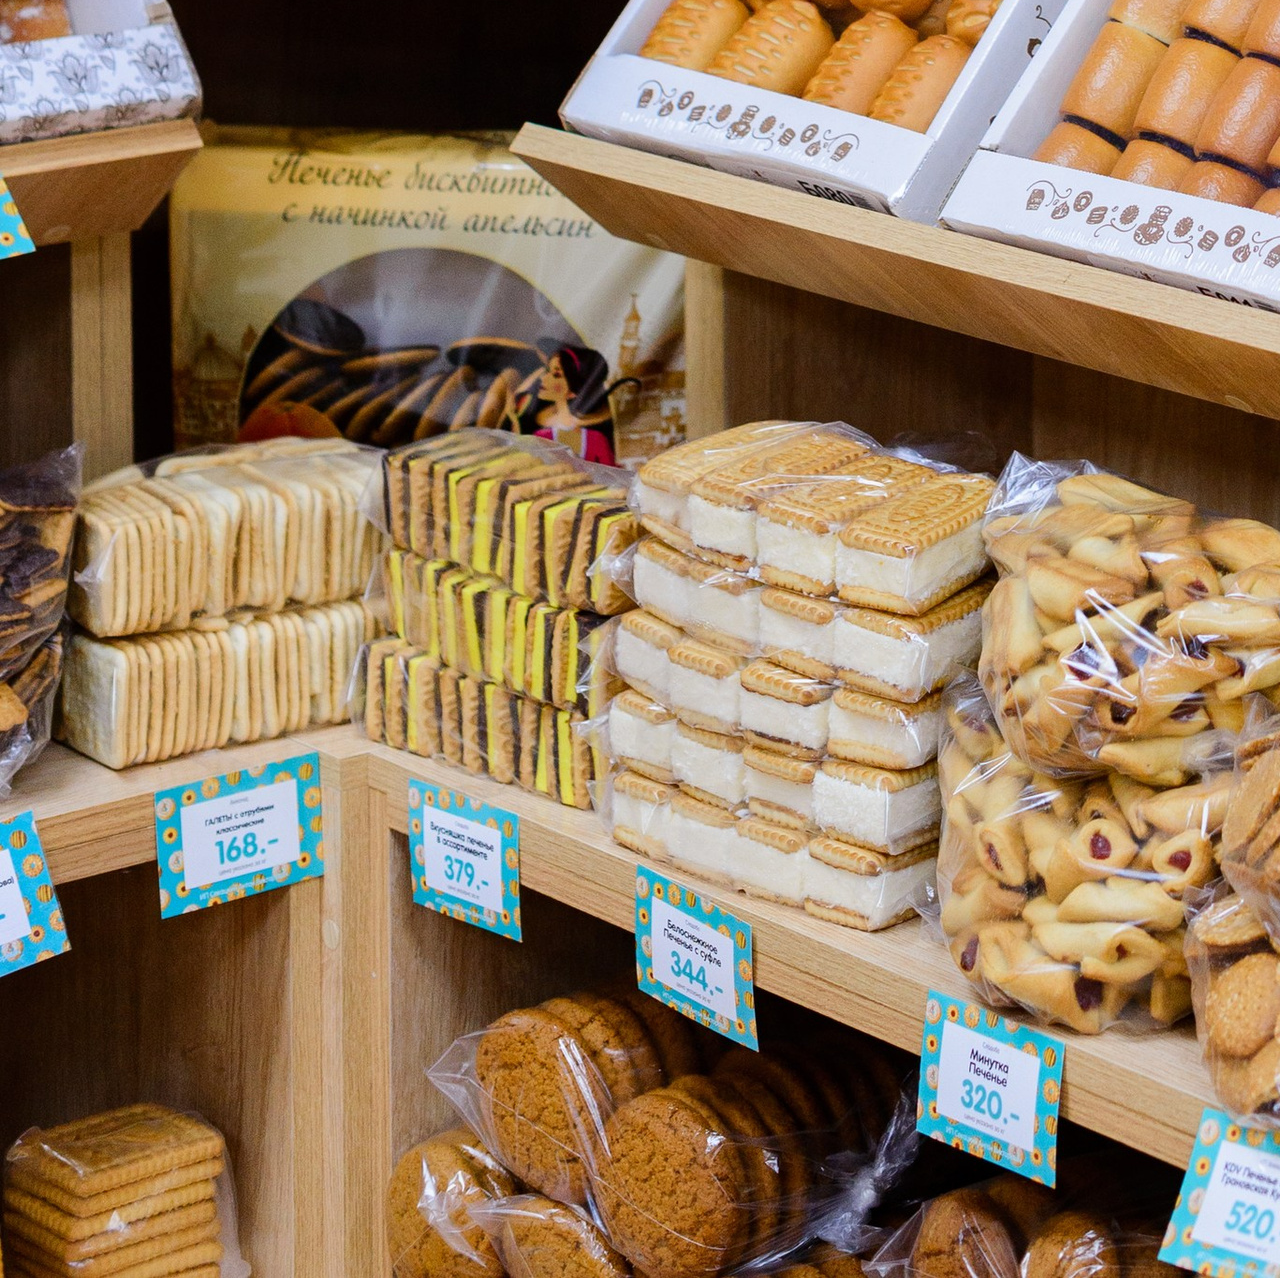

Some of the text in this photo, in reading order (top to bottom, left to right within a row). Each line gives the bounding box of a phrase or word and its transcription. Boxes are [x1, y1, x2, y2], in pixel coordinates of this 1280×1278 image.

[267, 151, 558, 201] Печенье бисквитно
[281, 198, 597, 241] с начинкой апельсин
[204, 814, 232, 827] ГАЛЕТЫ
[663, 928, 693, 952] Печенье
[700, 949, 722, 968] суфле
[968, 1061, 1008, 1088] Печенье
[969, 1048, 1009, 1075] Минутка
